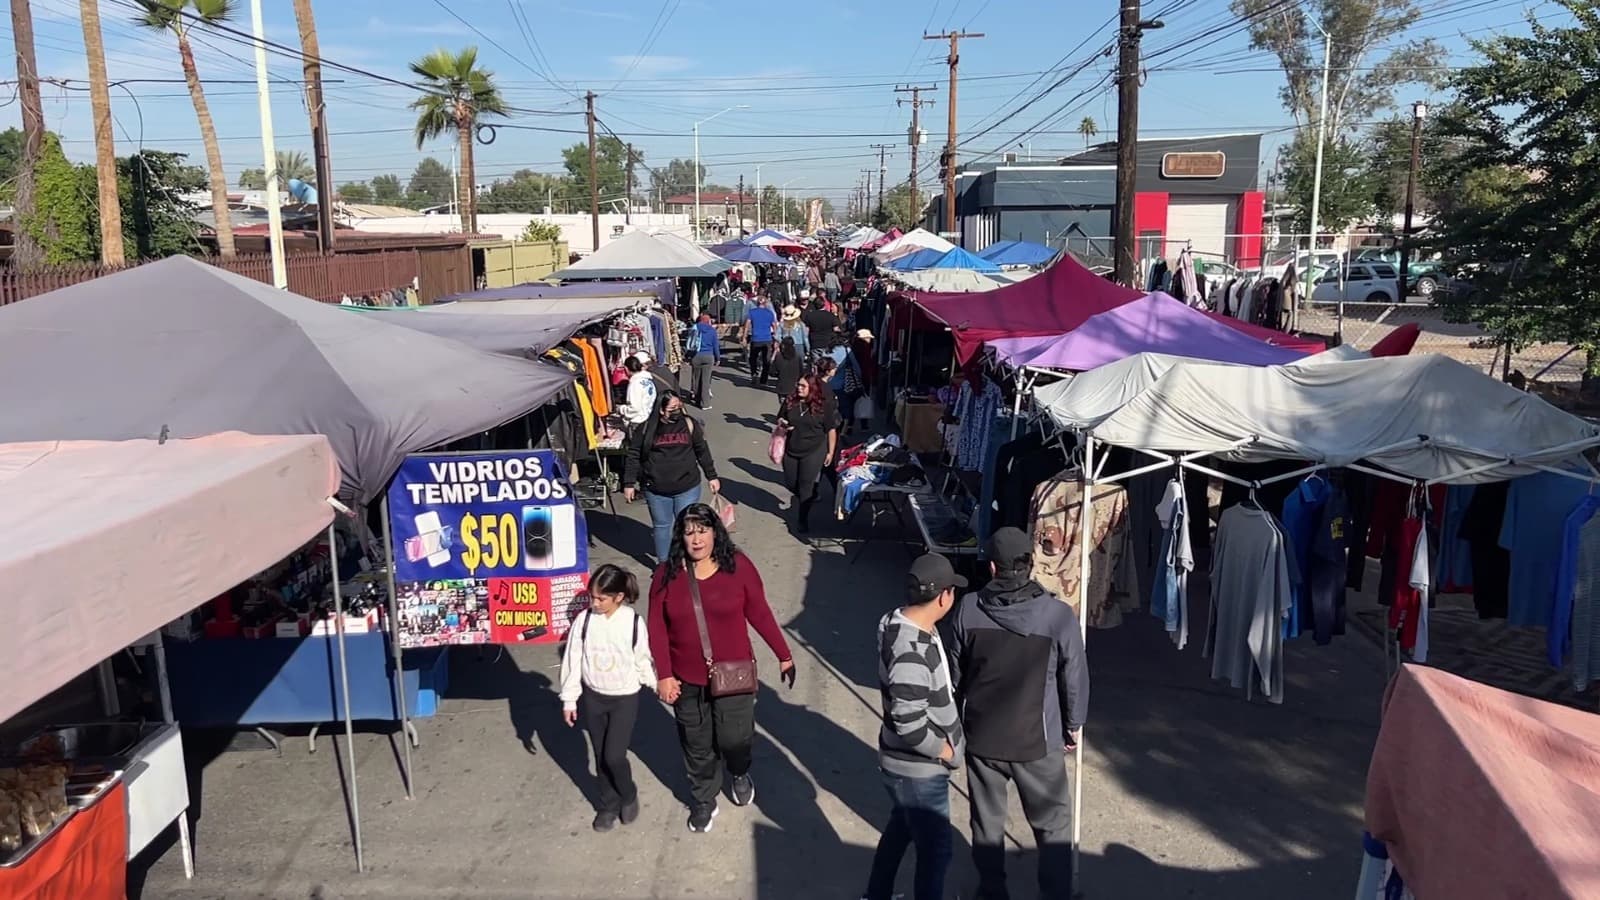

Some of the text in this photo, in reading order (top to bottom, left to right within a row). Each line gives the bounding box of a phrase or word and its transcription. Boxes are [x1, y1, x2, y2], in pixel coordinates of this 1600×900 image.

[429, 457, 542, 483] VIDRIOS
[406, 478, 567, 504] TEMPLADOS
[460, 512, 519, 576] $50
[550, 575, 582, 585] VARIADOS
[512, 582, 538, 604] USB
[495, 610, 513, 626] CON
[514, 610, 548, 626] MUSICA
